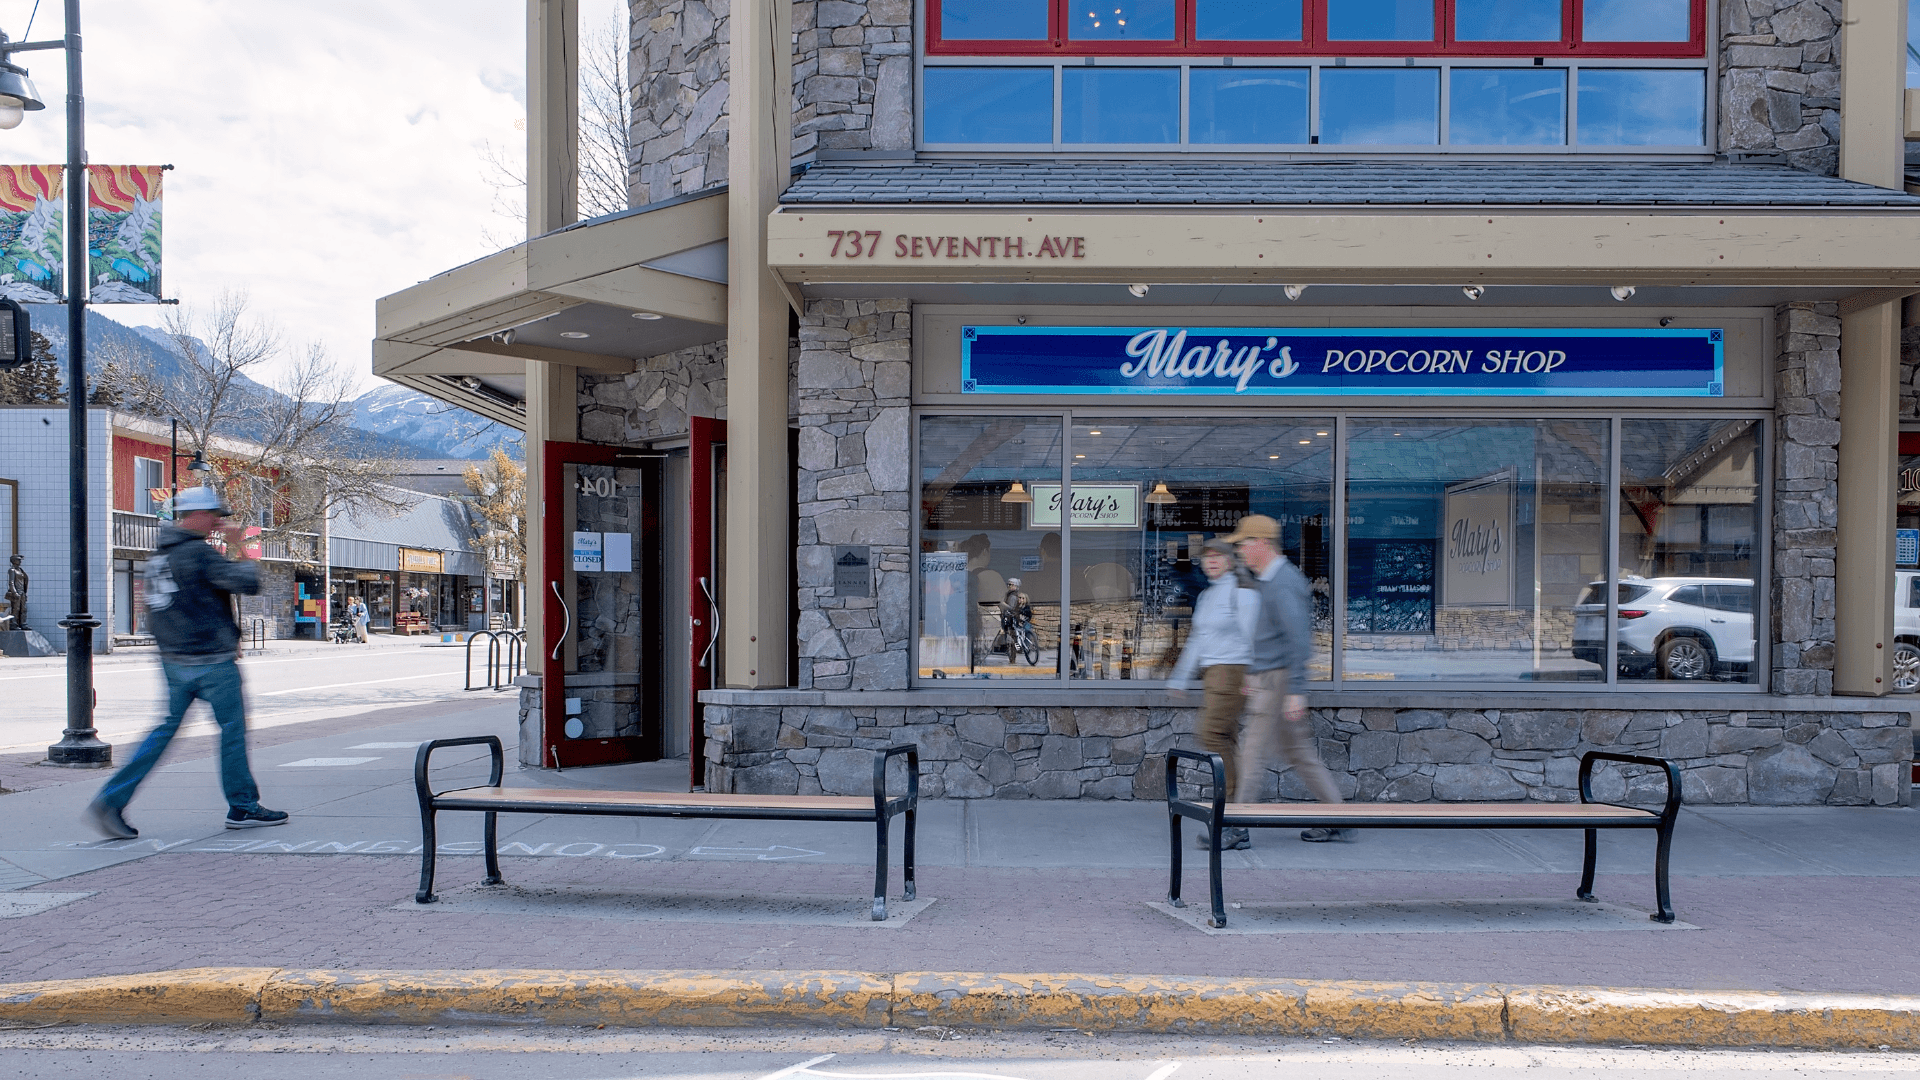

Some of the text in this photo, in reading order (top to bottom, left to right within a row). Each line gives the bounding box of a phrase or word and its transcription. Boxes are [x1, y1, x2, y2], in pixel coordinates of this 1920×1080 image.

[827, 230, 1086, 258] 737 SEVENTH AVE
[1120, 329, 1567, 393] Mary's POPCORN SHOP
[1049, 491, 1120, 520] Mary's
[1450, 518, 1502, 575] Mary's
